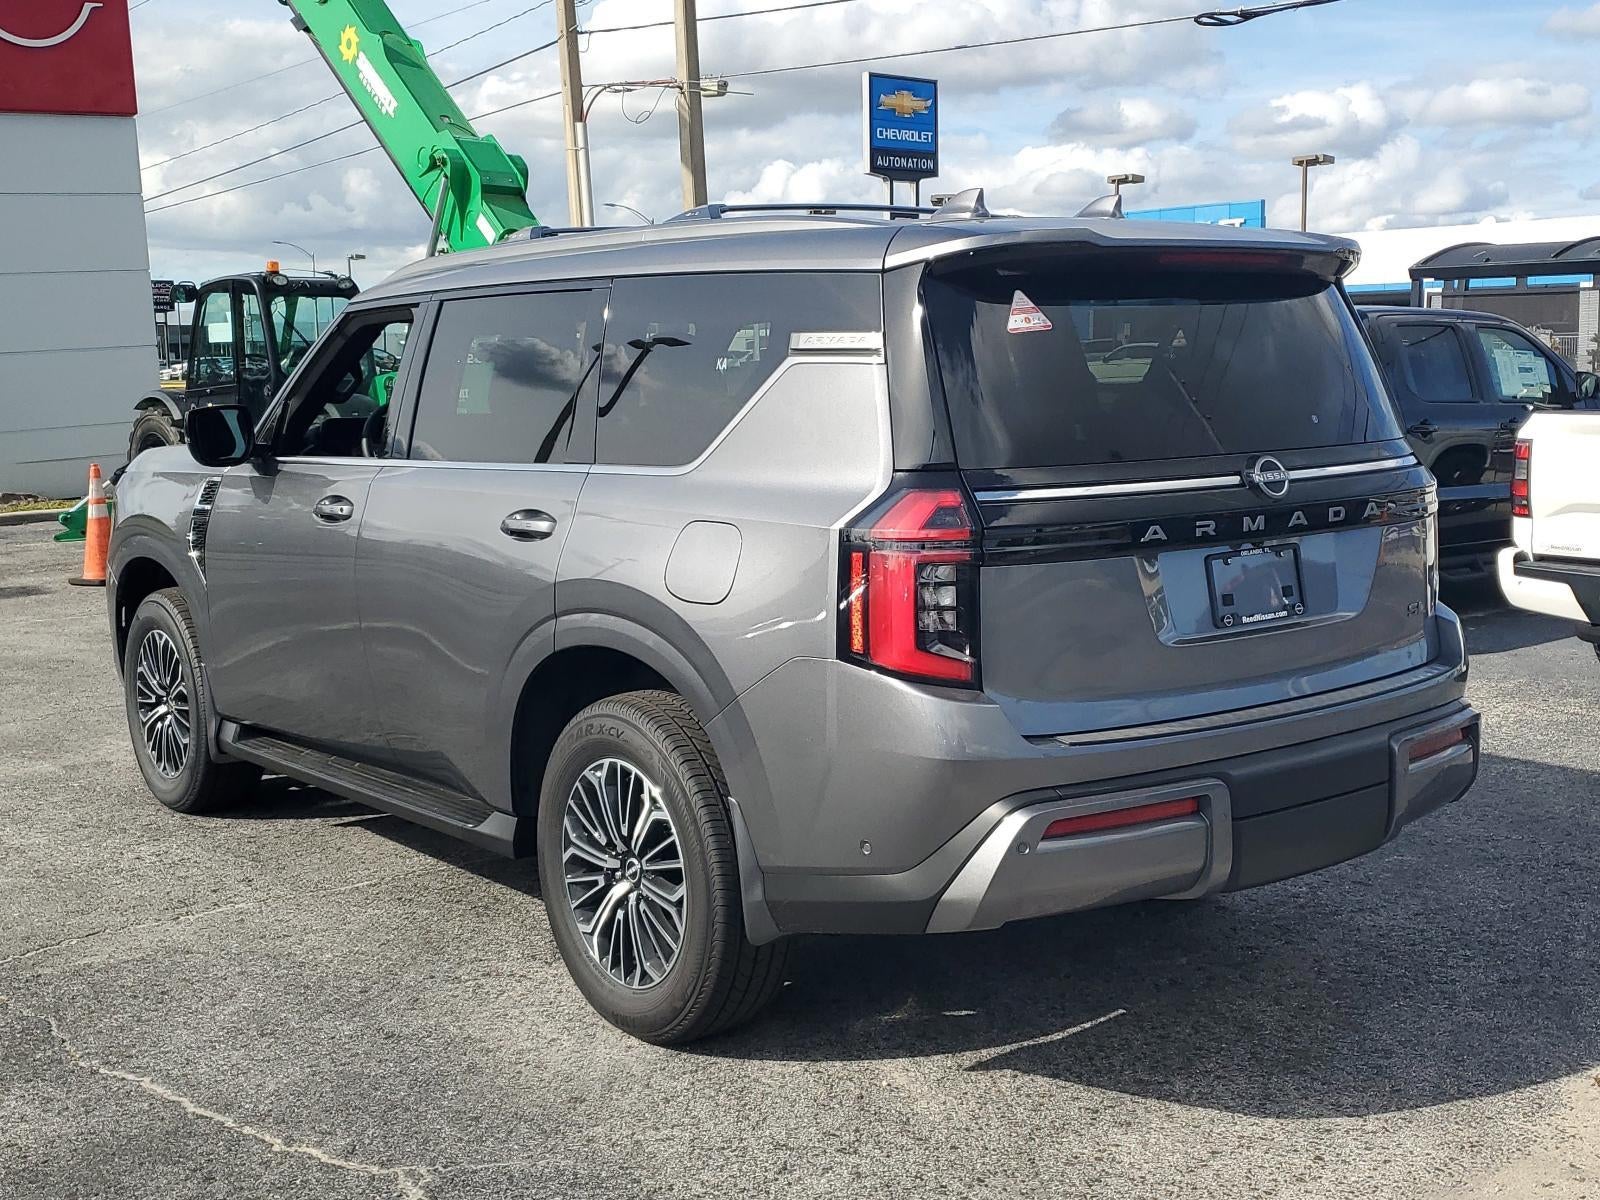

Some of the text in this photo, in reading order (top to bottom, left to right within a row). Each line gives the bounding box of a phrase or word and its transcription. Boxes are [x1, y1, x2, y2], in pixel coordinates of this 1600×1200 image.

[876, 127, 933, 143] CHEVROLET
[876, 154, 934, 170] AUTONATION
[1255, 471, 1289, 482] NISSAN
[1139, 501, 1381, 542] ARMADA
